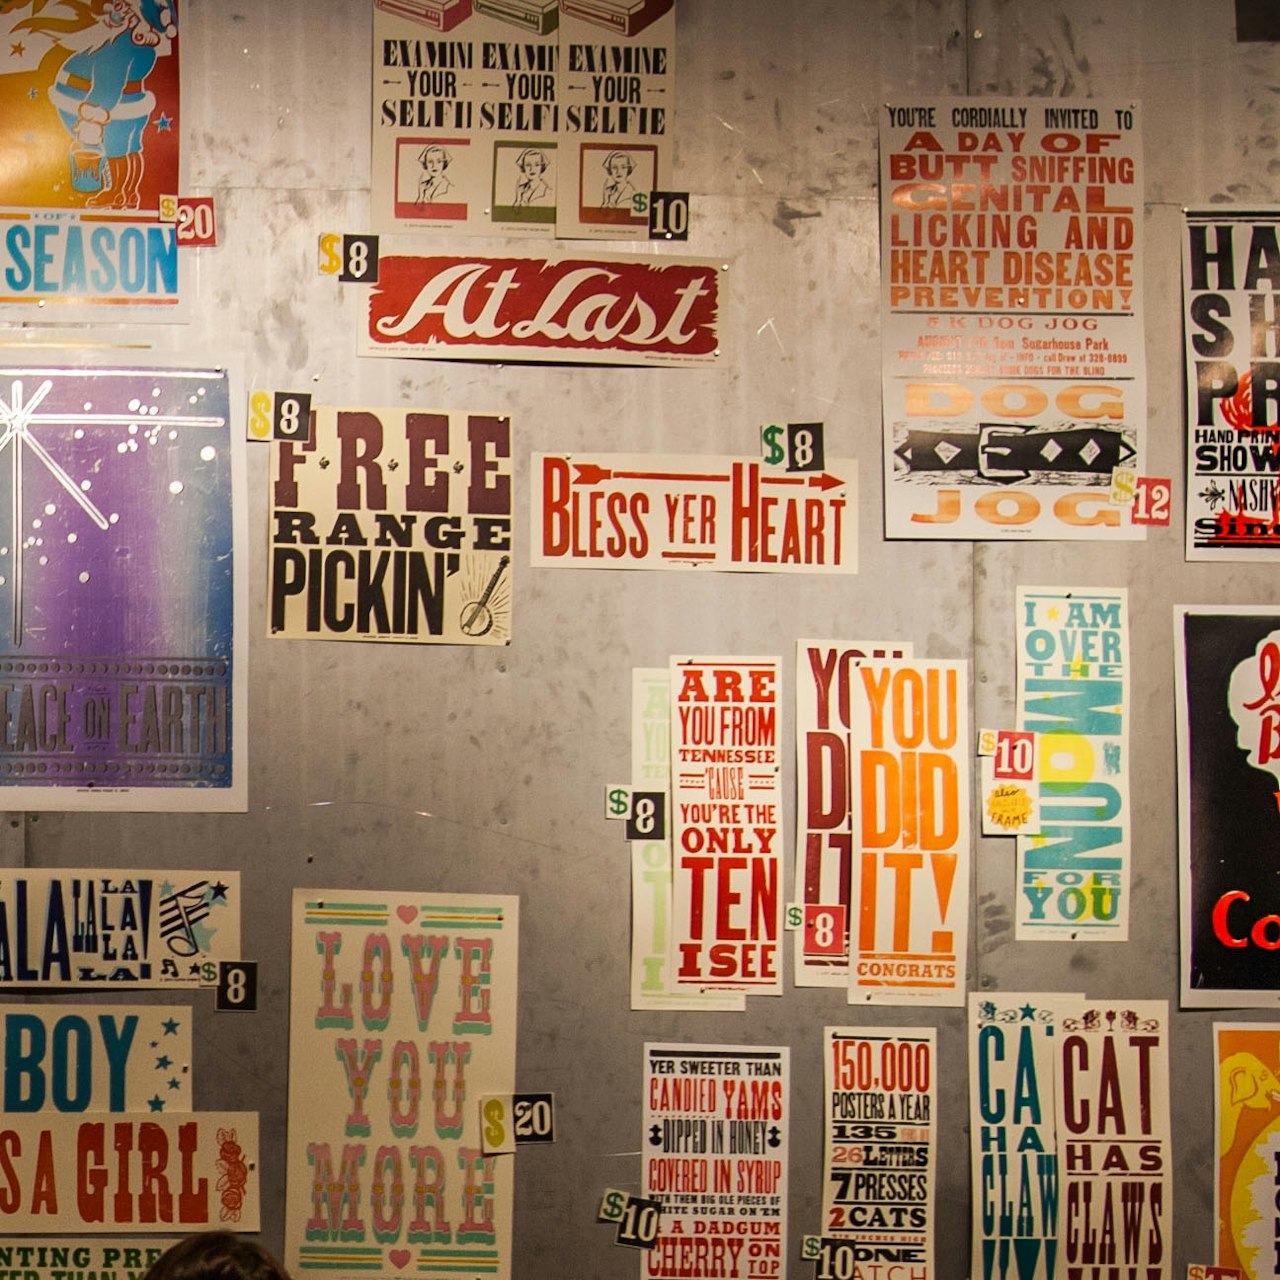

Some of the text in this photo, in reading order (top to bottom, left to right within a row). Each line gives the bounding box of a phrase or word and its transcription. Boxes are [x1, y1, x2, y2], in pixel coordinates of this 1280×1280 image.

[569, 45, 666, 75] EXAMINE
[592, 76, 641, 104] YOUR
[566, 107, 666, 136] SELFIE
[889, 107, 1133, 130] YOU'RE CORDIALLY INVITED TO
[6, 226, 179, 294] SEASON
[378, 264, 710, 346] At Last
[274, 511, 511, 551] RANGE
[543, 456, 846, 566] BLESS YER HEART
[274, 548, 460, 636] PICKIN'
[118, 684, 228, 755] EARTH
[859, 668, 958, 750] YOU
[678, 748, 775, 764] TENNESSEE
[681, 827, 774, 854] ONLY
[681, 858, 778, 940] TEN
[856, 962, 956, 978] CONGRATS
[5, 1015, 141, 1114] BOY
[650, 1060, 781, 1076] YER SWEETER THAN
[832, 1040, 930, 1092] 150,000
[1063, 1036, 1160, 1137] CAT
[650, 1077, 782, 1120] CANDIED YAMS
[77, 1121, 209, 1225] GIRL
[831, 1173, 927, 1201] 7 PRESSES
[829, 1207, 926, 1227] 2 CATS
[1066, 1182, 1163, 1265] CLAWS
